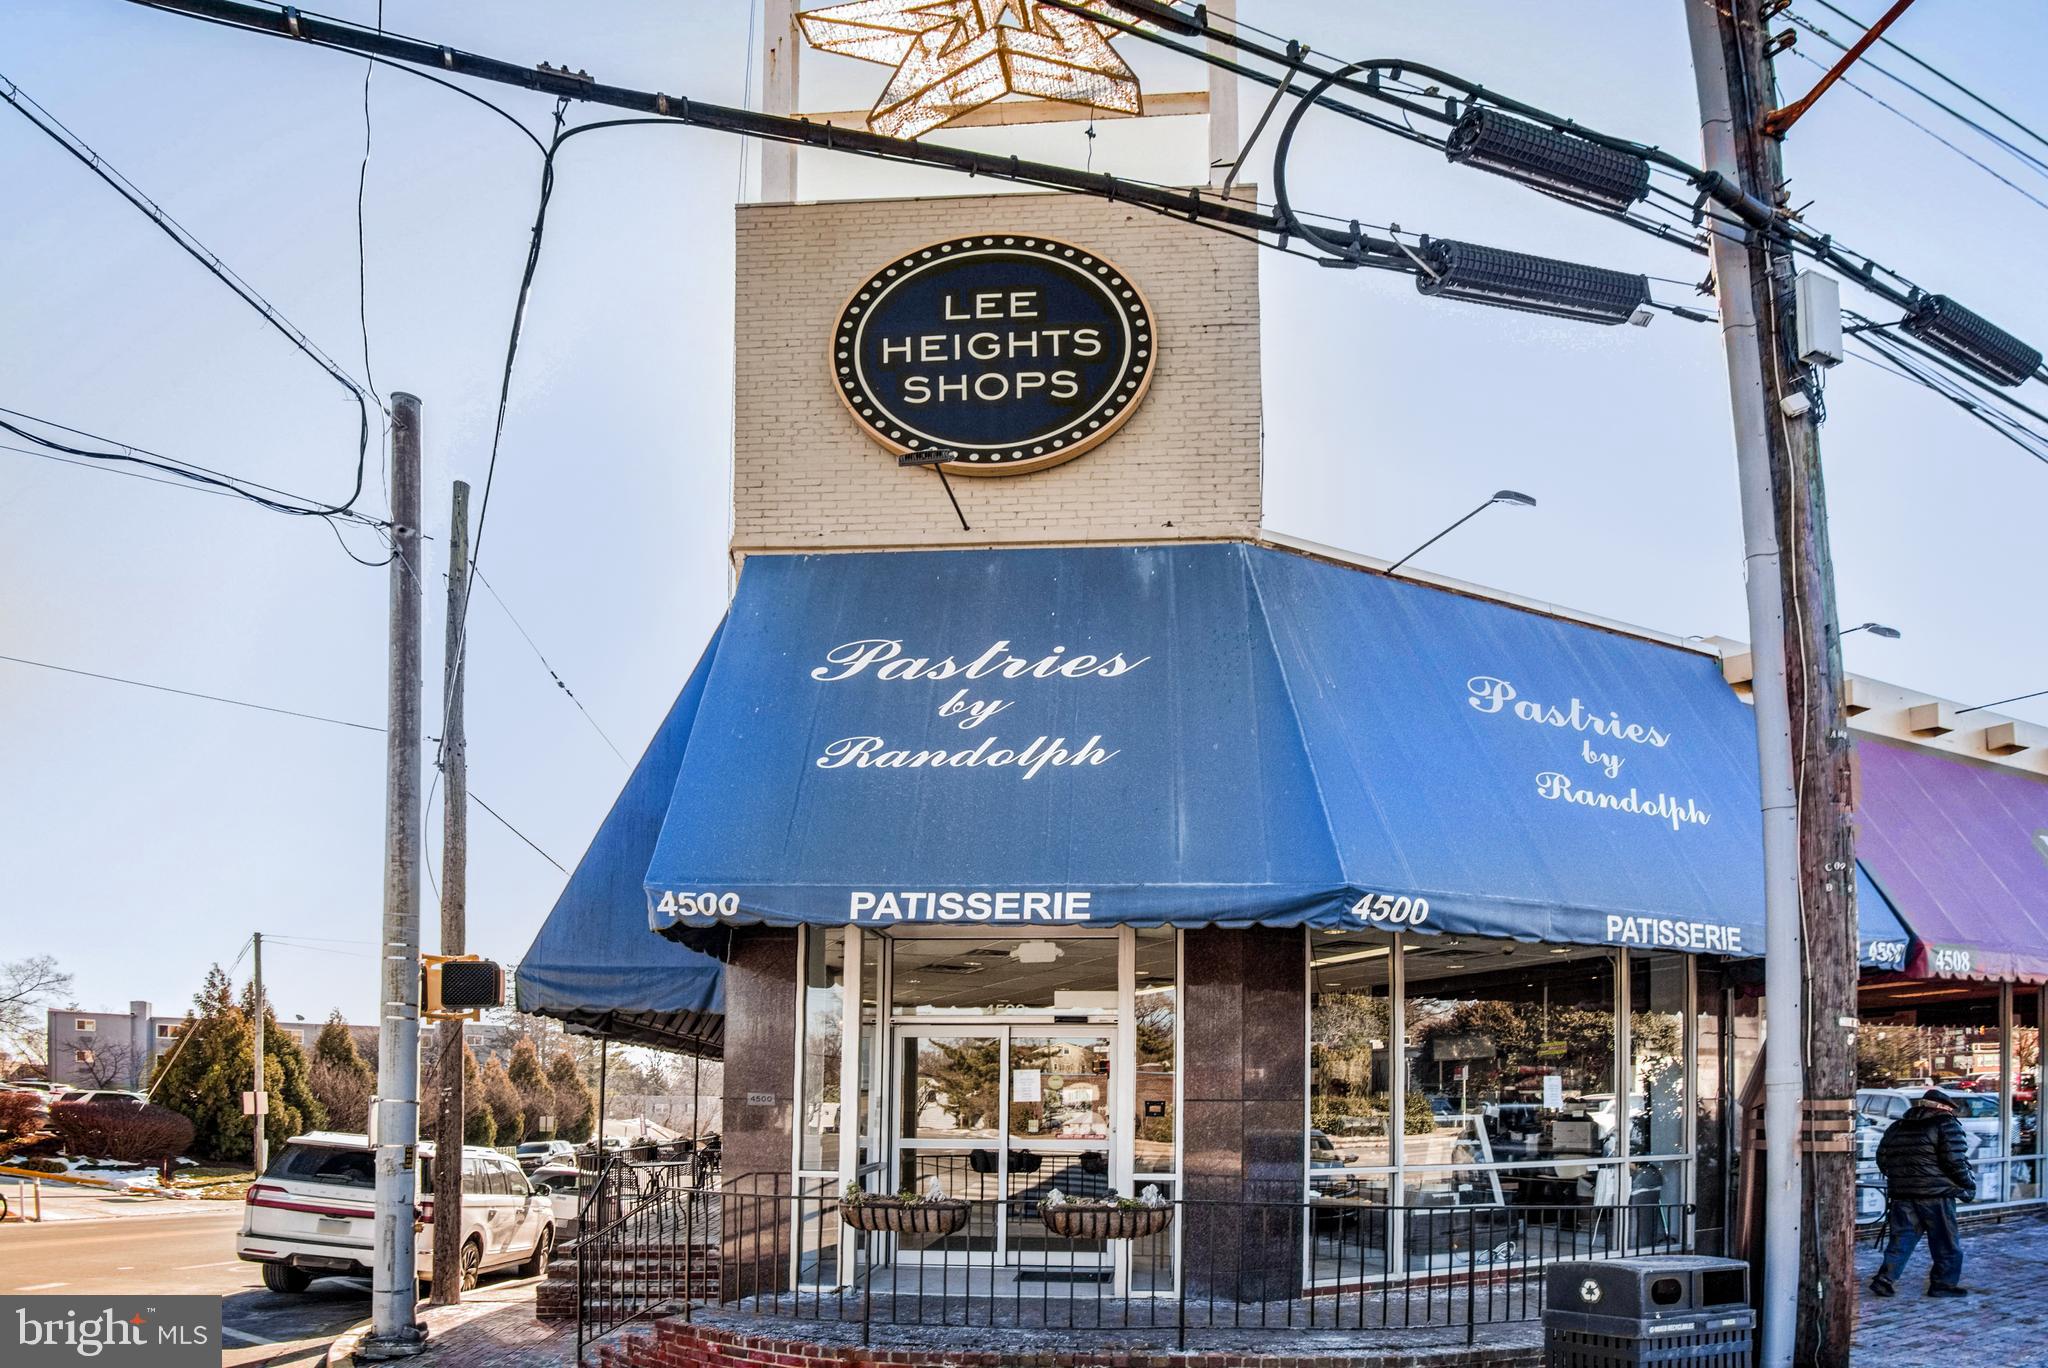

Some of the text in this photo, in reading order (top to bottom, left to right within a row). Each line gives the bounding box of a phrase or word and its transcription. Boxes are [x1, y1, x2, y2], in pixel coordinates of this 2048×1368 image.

[945, 291, 1038, 320] LEE
[883, 328, 1101, 364] HEIGHTS
[904, 370, 1078, 404] SHOPS
[811, 639, 1151, 681] Pastries
[938, 689, 1015, 729] by
[1467, 676, 1671, 747] Pastries
[816, 735, 1121, 780] Randolph
[1582, 740, 1626, 779] by
[1535, 771, 1712, 831] Randolph
[656, 891, 741, 917] 4500
[850, 891, 1091, 920] PATISSERIE
[1351, 893, 1429, 925] 4500
[1607, 914, 1743, 952] PATISSERIE
[1936, 950, 1970, 972] 4508
[750, 1095, 773, 1103] 4500
